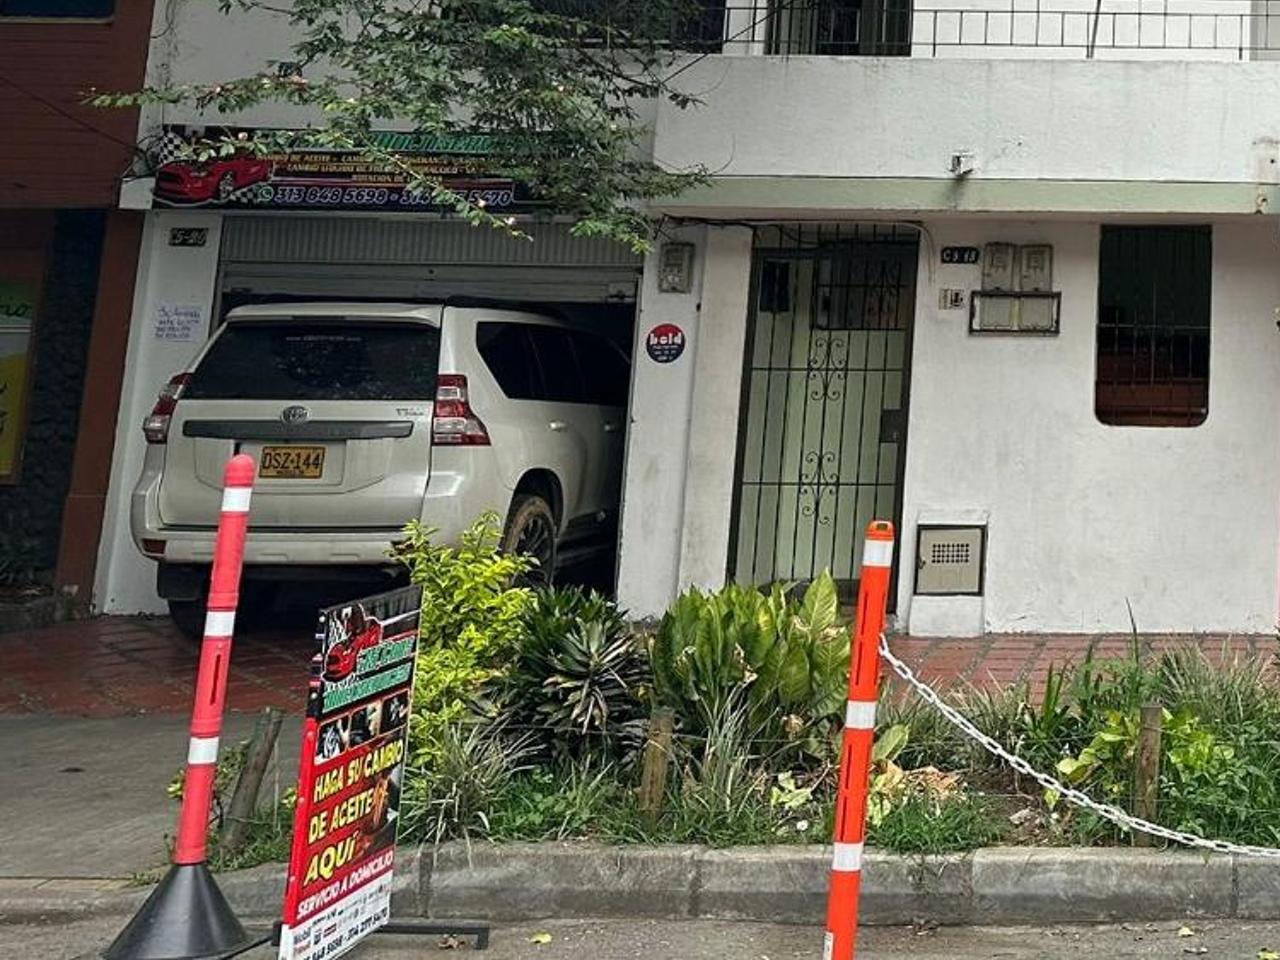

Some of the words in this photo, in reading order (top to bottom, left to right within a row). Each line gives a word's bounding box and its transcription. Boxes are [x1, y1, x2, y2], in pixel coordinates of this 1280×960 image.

[274, 186, 306, 204] 313
[342, 187, 389, 205] 5698
[313, 765, 344, 803] HAGA
[347, 757, 365, 786] SU
[364, 739, 404, 778] CAMBIO
[308, 811, 328, 845] DE
[329, 788, 375, 833] ACEITE
[297, 880, 341, 921] SERVICIO
[340, 875, 348, 895] A
[349, 850, 394, 889] DOMICILIO
